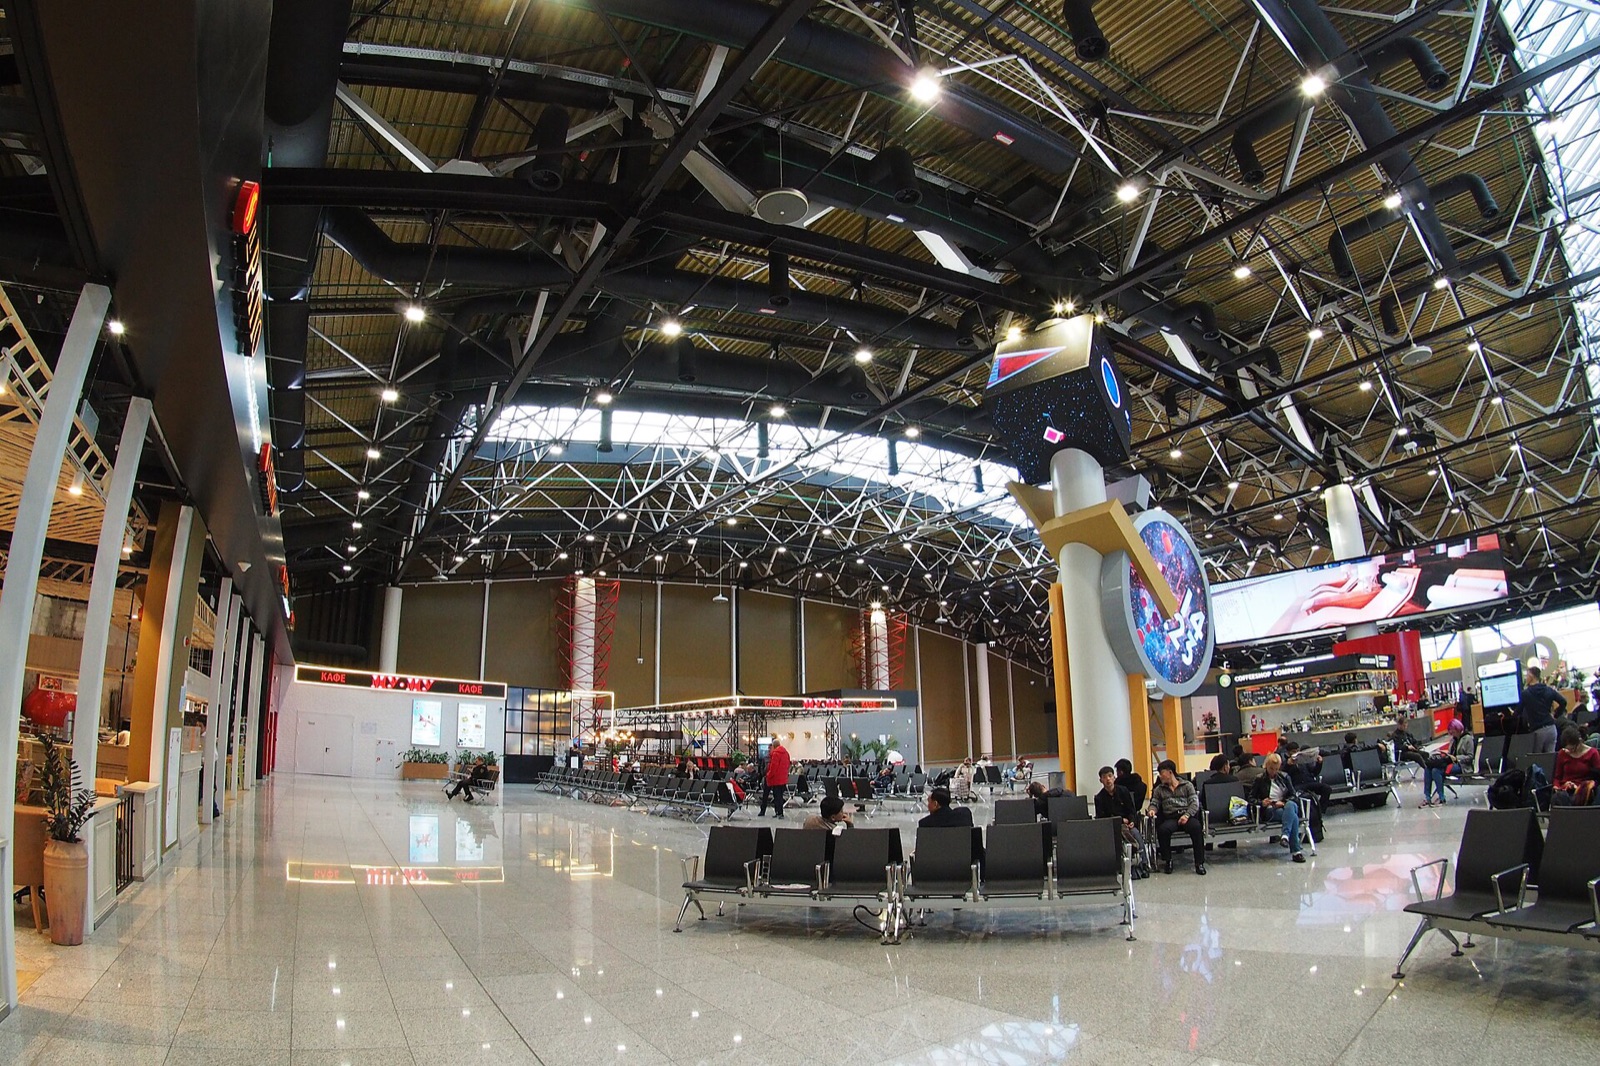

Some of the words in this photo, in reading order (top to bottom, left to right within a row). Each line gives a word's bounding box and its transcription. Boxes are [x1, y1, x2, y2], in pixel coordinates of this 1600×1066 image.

[246, 238, 262, 357] PATIO
[321, 671, 346, 683] КАФЕ
[458, 683, 483, 694] КАФЕ
[1234, 671, 1272, 682] COFFEESHOP
[1273, 666, 1304, 677] COMPANY
[764, 699, 782, 707] КАФЕ
